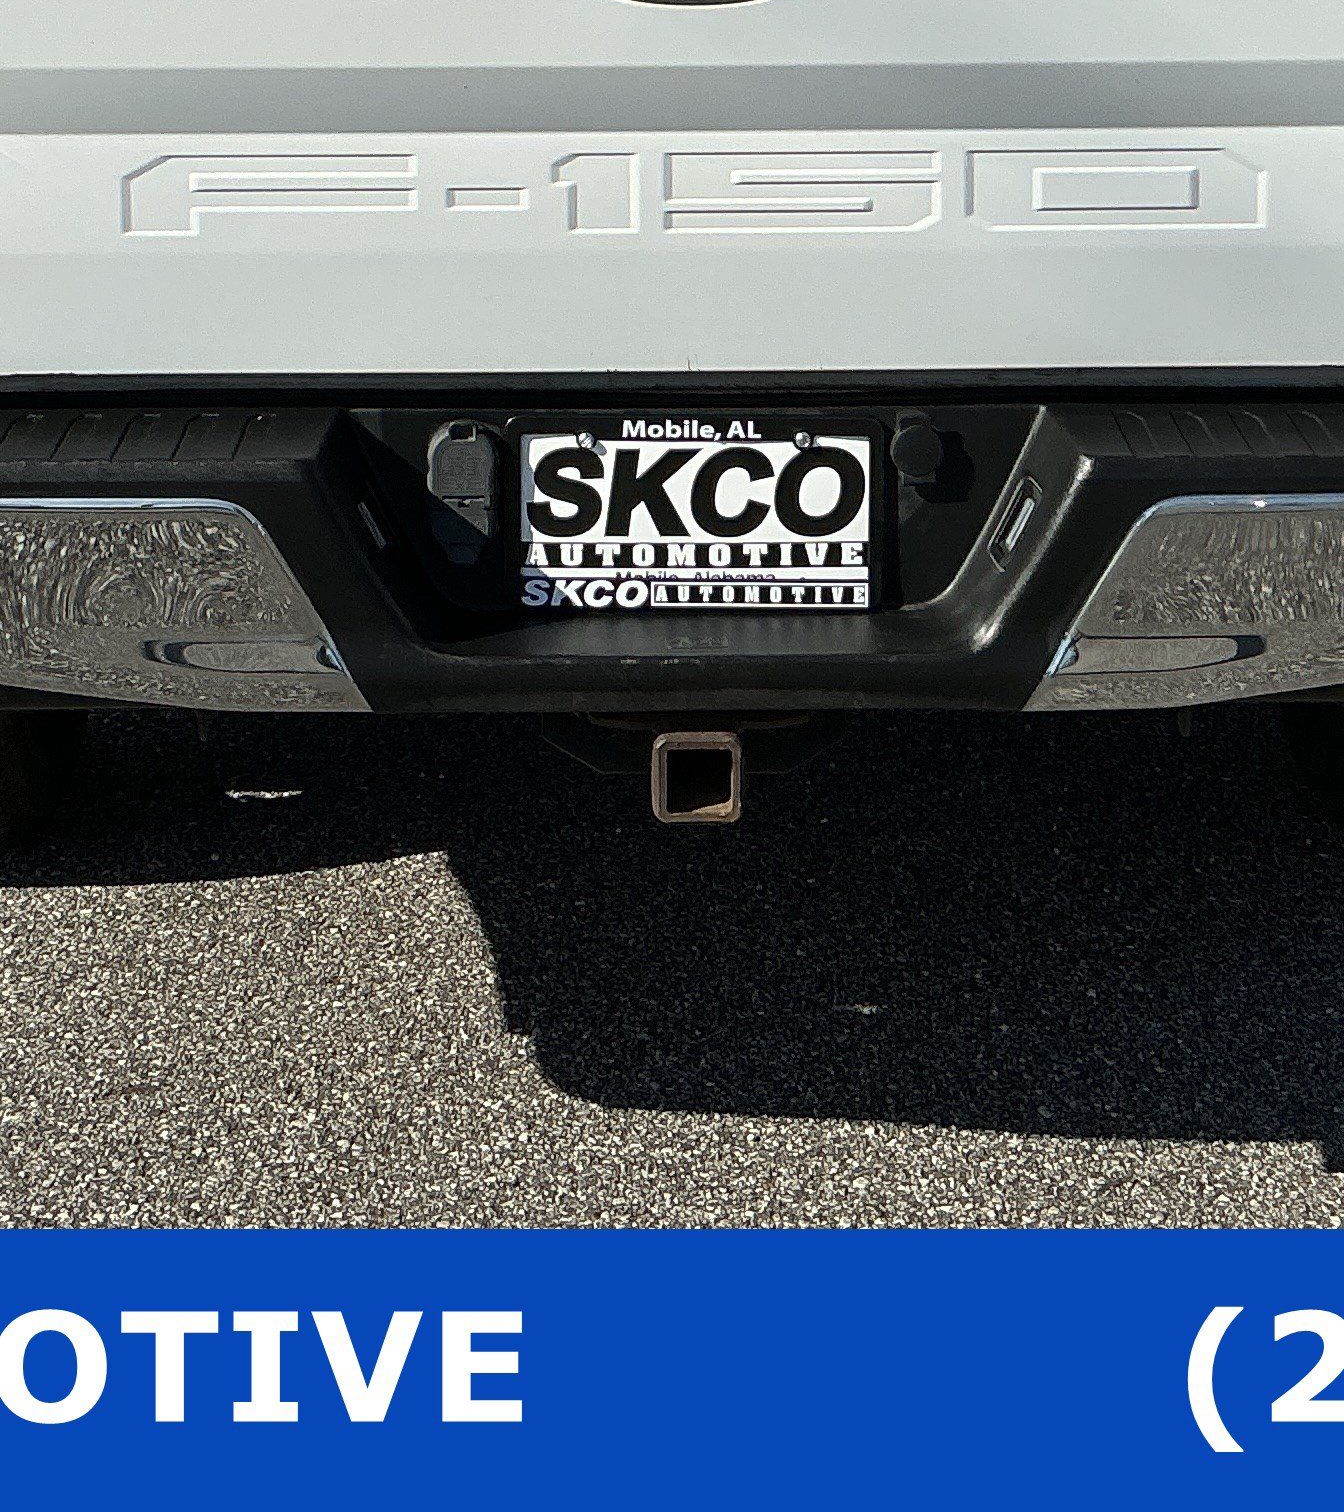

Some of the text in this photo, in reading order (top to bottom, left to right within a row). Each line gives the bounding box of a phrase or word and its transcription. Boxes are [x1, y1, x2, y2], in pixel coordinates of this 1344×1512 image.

[122, 148, 1268, 236] F-150
[621, 419, 762, 442] Mobile, AL
[527, 446, 866, 538] SKCO
[529, 542, 864, 567] AUTOMOTIVE
[521, 580, 866, 607] SKCO AUTOMOTIVE
